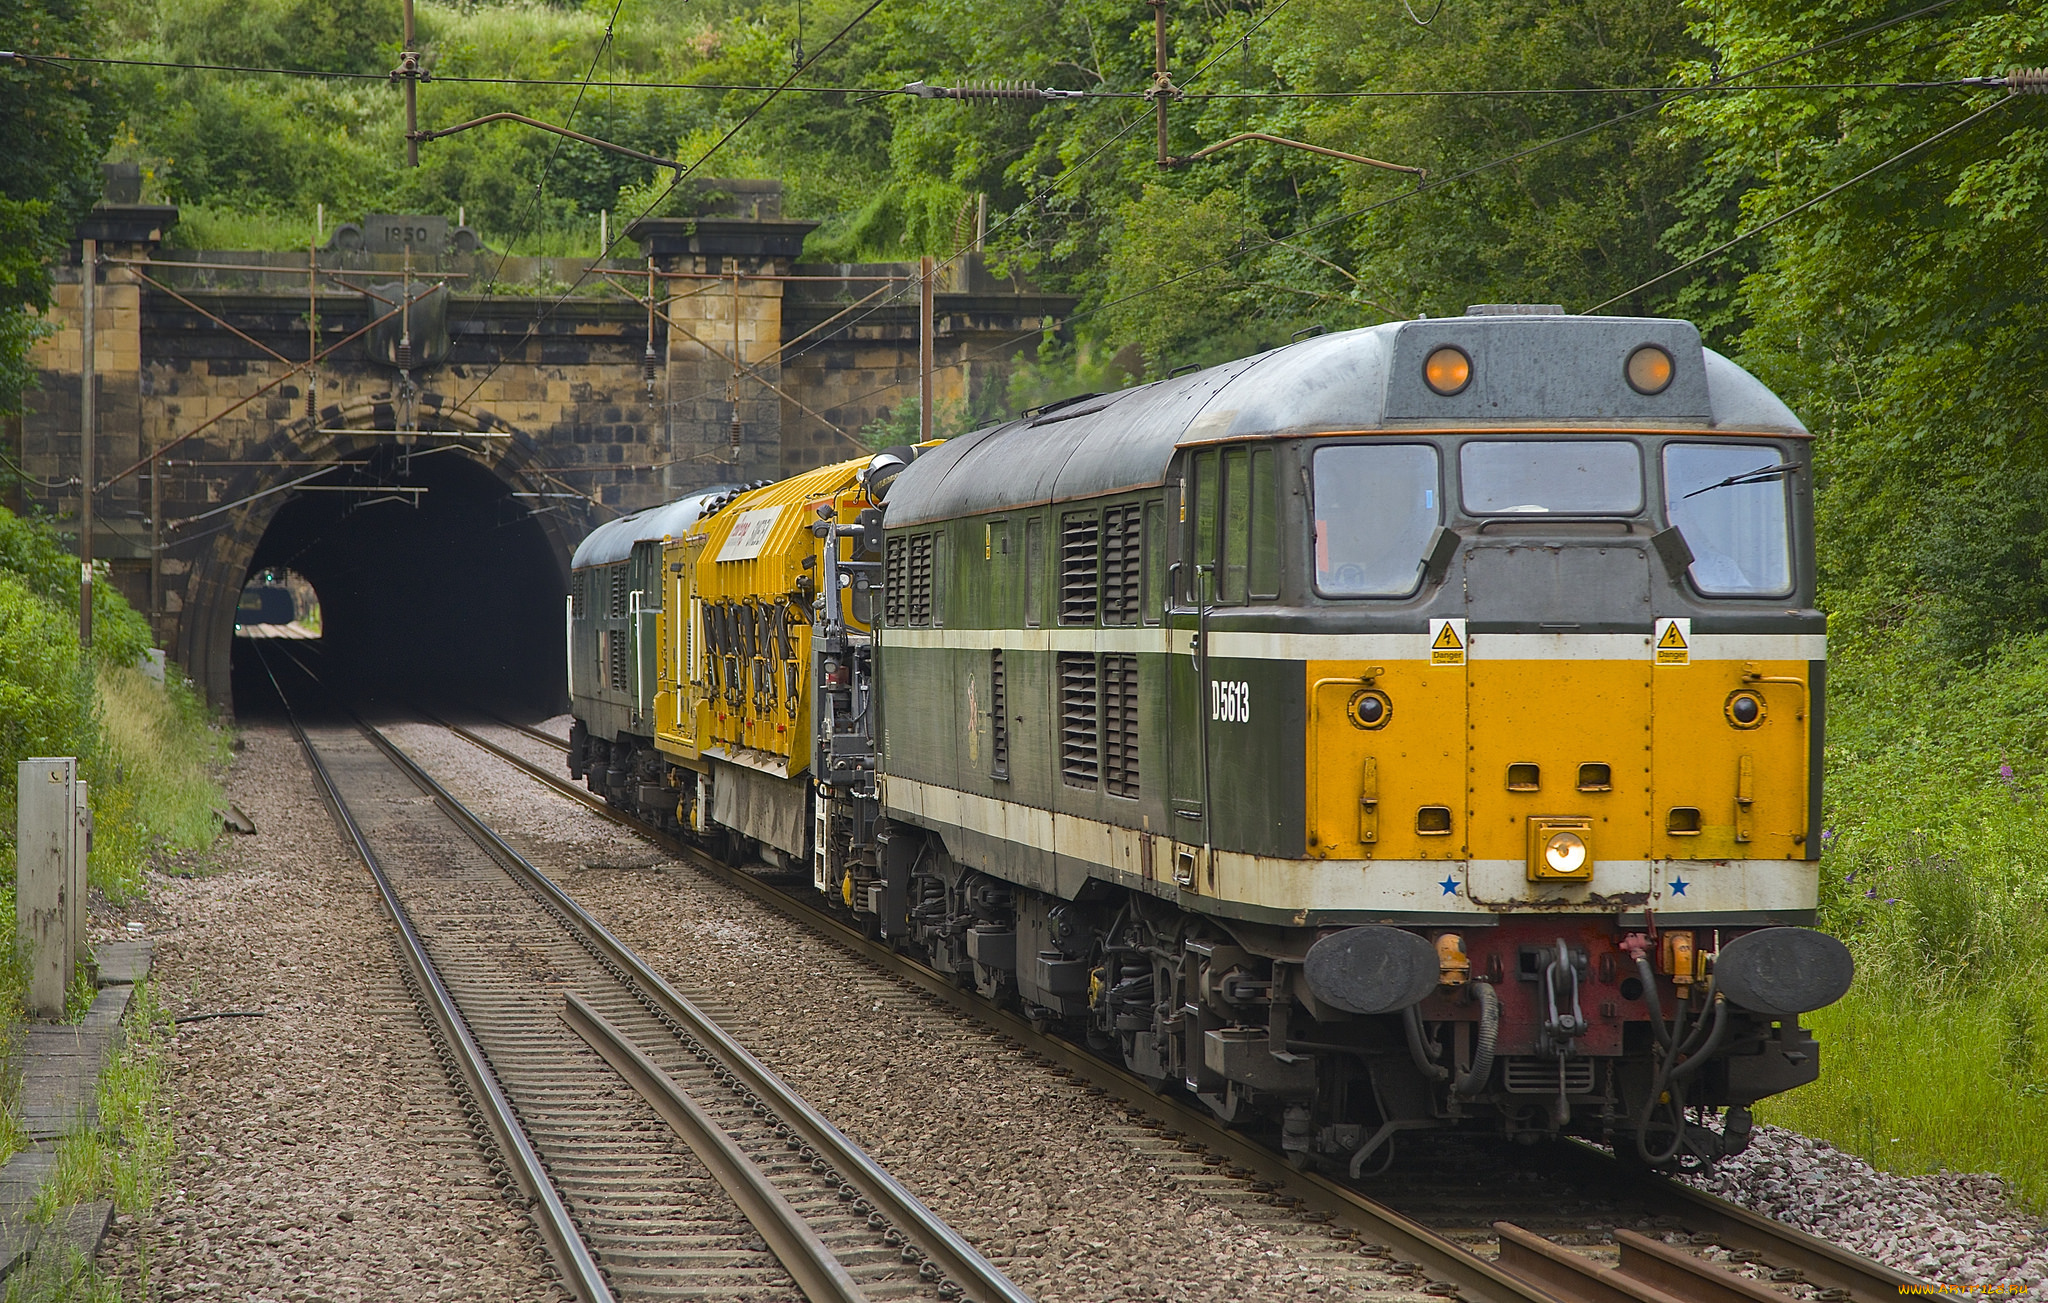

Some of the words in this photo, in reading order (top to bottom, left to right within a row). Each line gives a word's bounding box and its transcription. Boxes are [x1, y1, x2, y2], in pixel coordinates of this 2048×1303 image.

[384, 226, 427, 243] 1850
[1433, 651, 1462, 660] Danger
[1658, 650, 1687, 660] Danger
[1211, 680, 1250, 723] D5613
